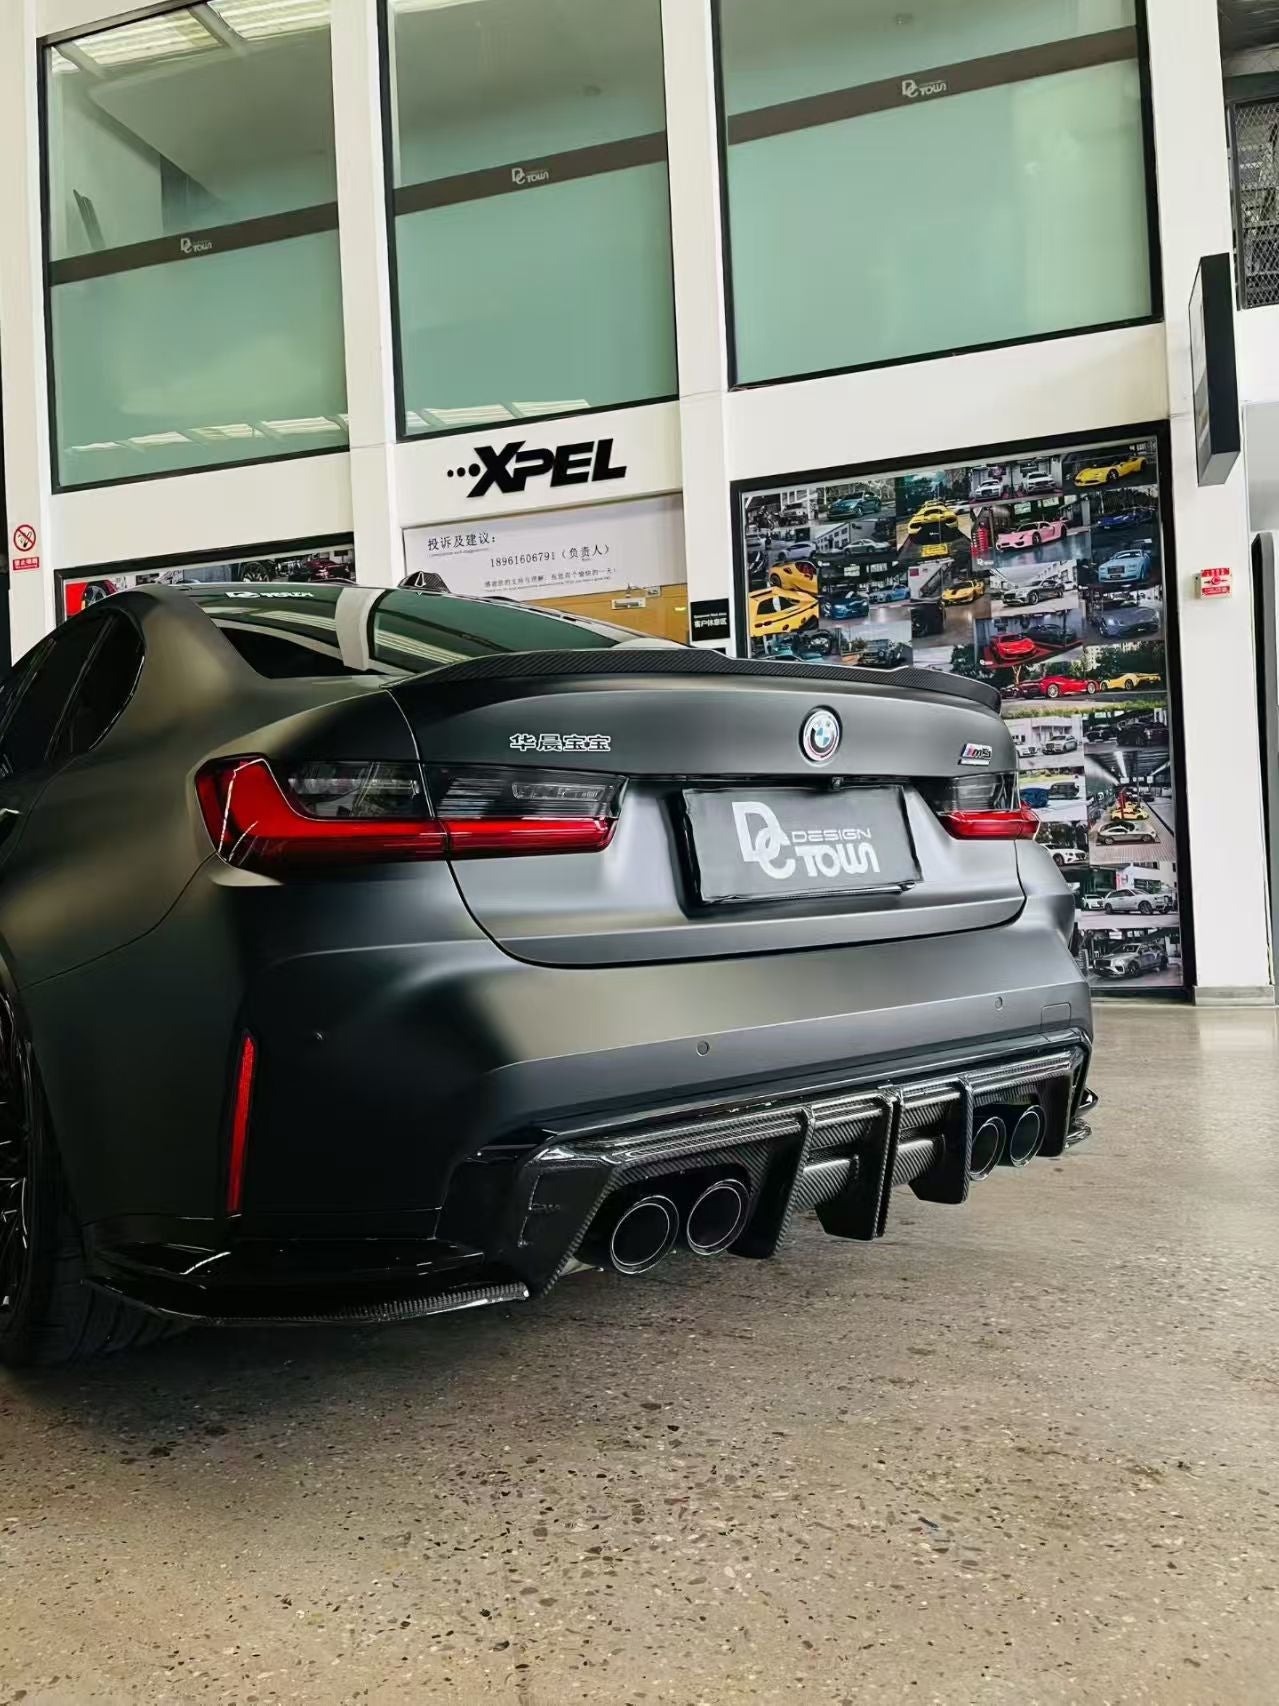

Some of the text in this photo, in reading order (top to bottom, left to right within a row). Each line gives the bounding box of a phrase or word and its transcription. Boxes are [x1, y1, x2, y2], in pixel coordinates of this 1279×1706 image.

[467, 438, 627, 498] XPEL
[509, 733, 611, 752] 华晨宝宝
[791, 828, 872, 843] DESIGN
[794, 842, 881, 878] TOWN
